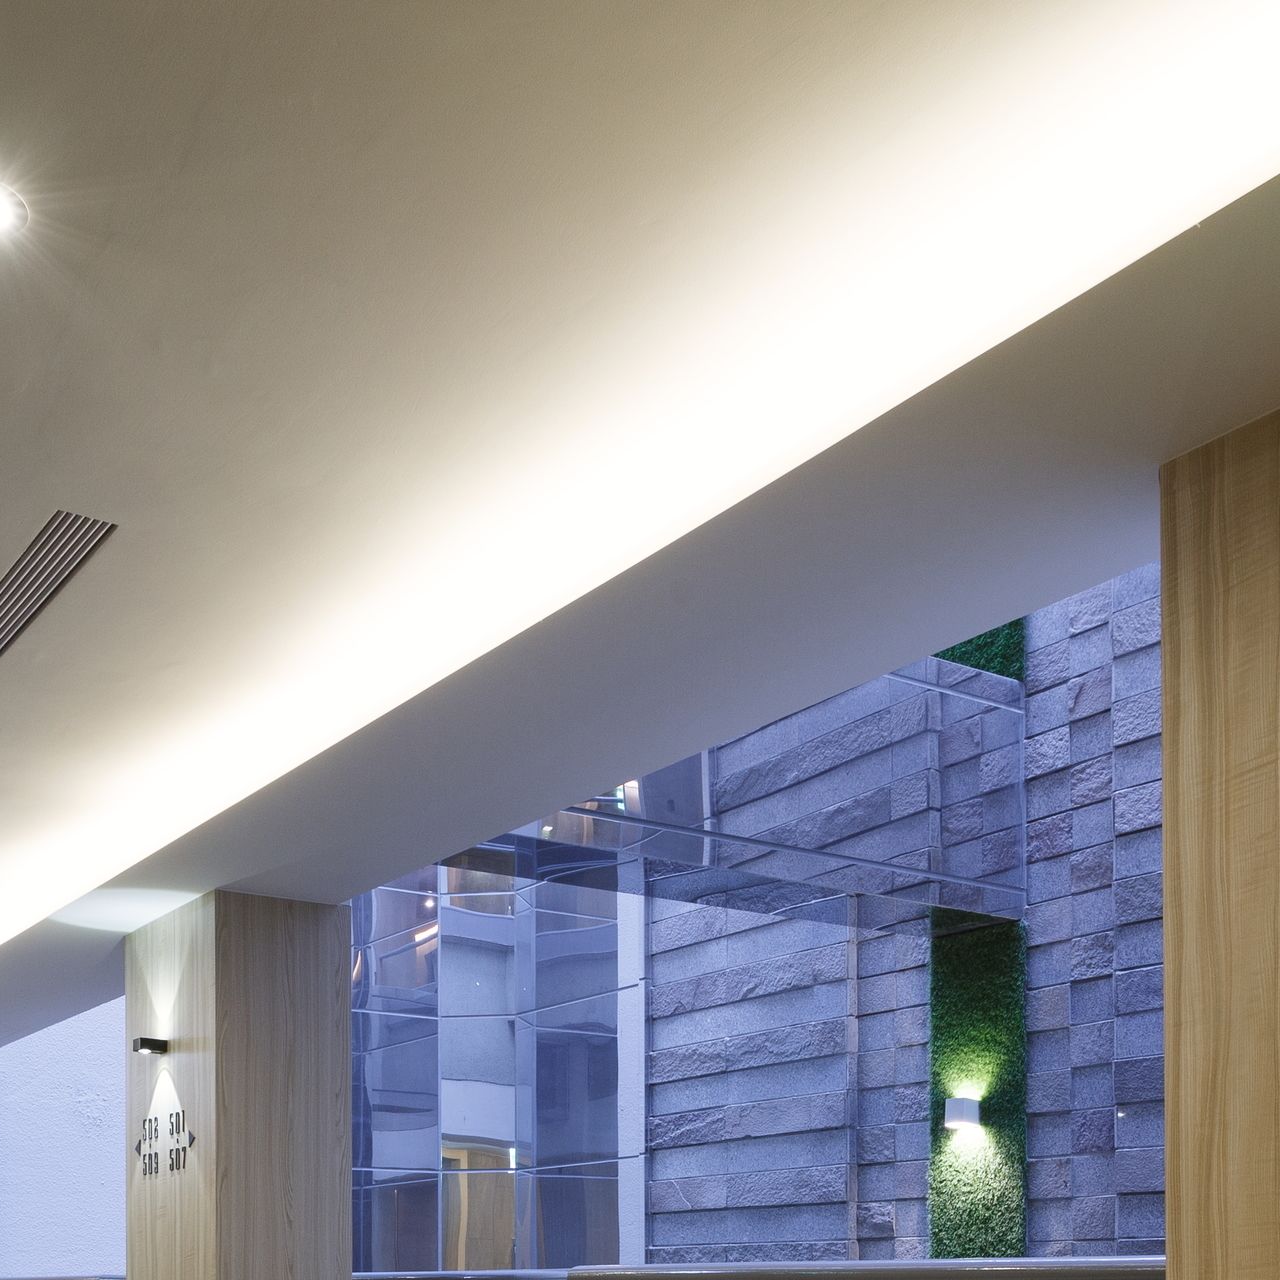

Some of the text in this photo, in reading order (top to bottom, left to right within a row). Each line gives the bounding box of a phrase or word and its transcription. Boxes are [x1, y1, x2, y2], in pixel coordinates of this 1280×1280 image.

[169, 1109, 185, 1136] 501
[142, 1151, 159, 1176] 509
[169, 1146, 187, 1172] 507
